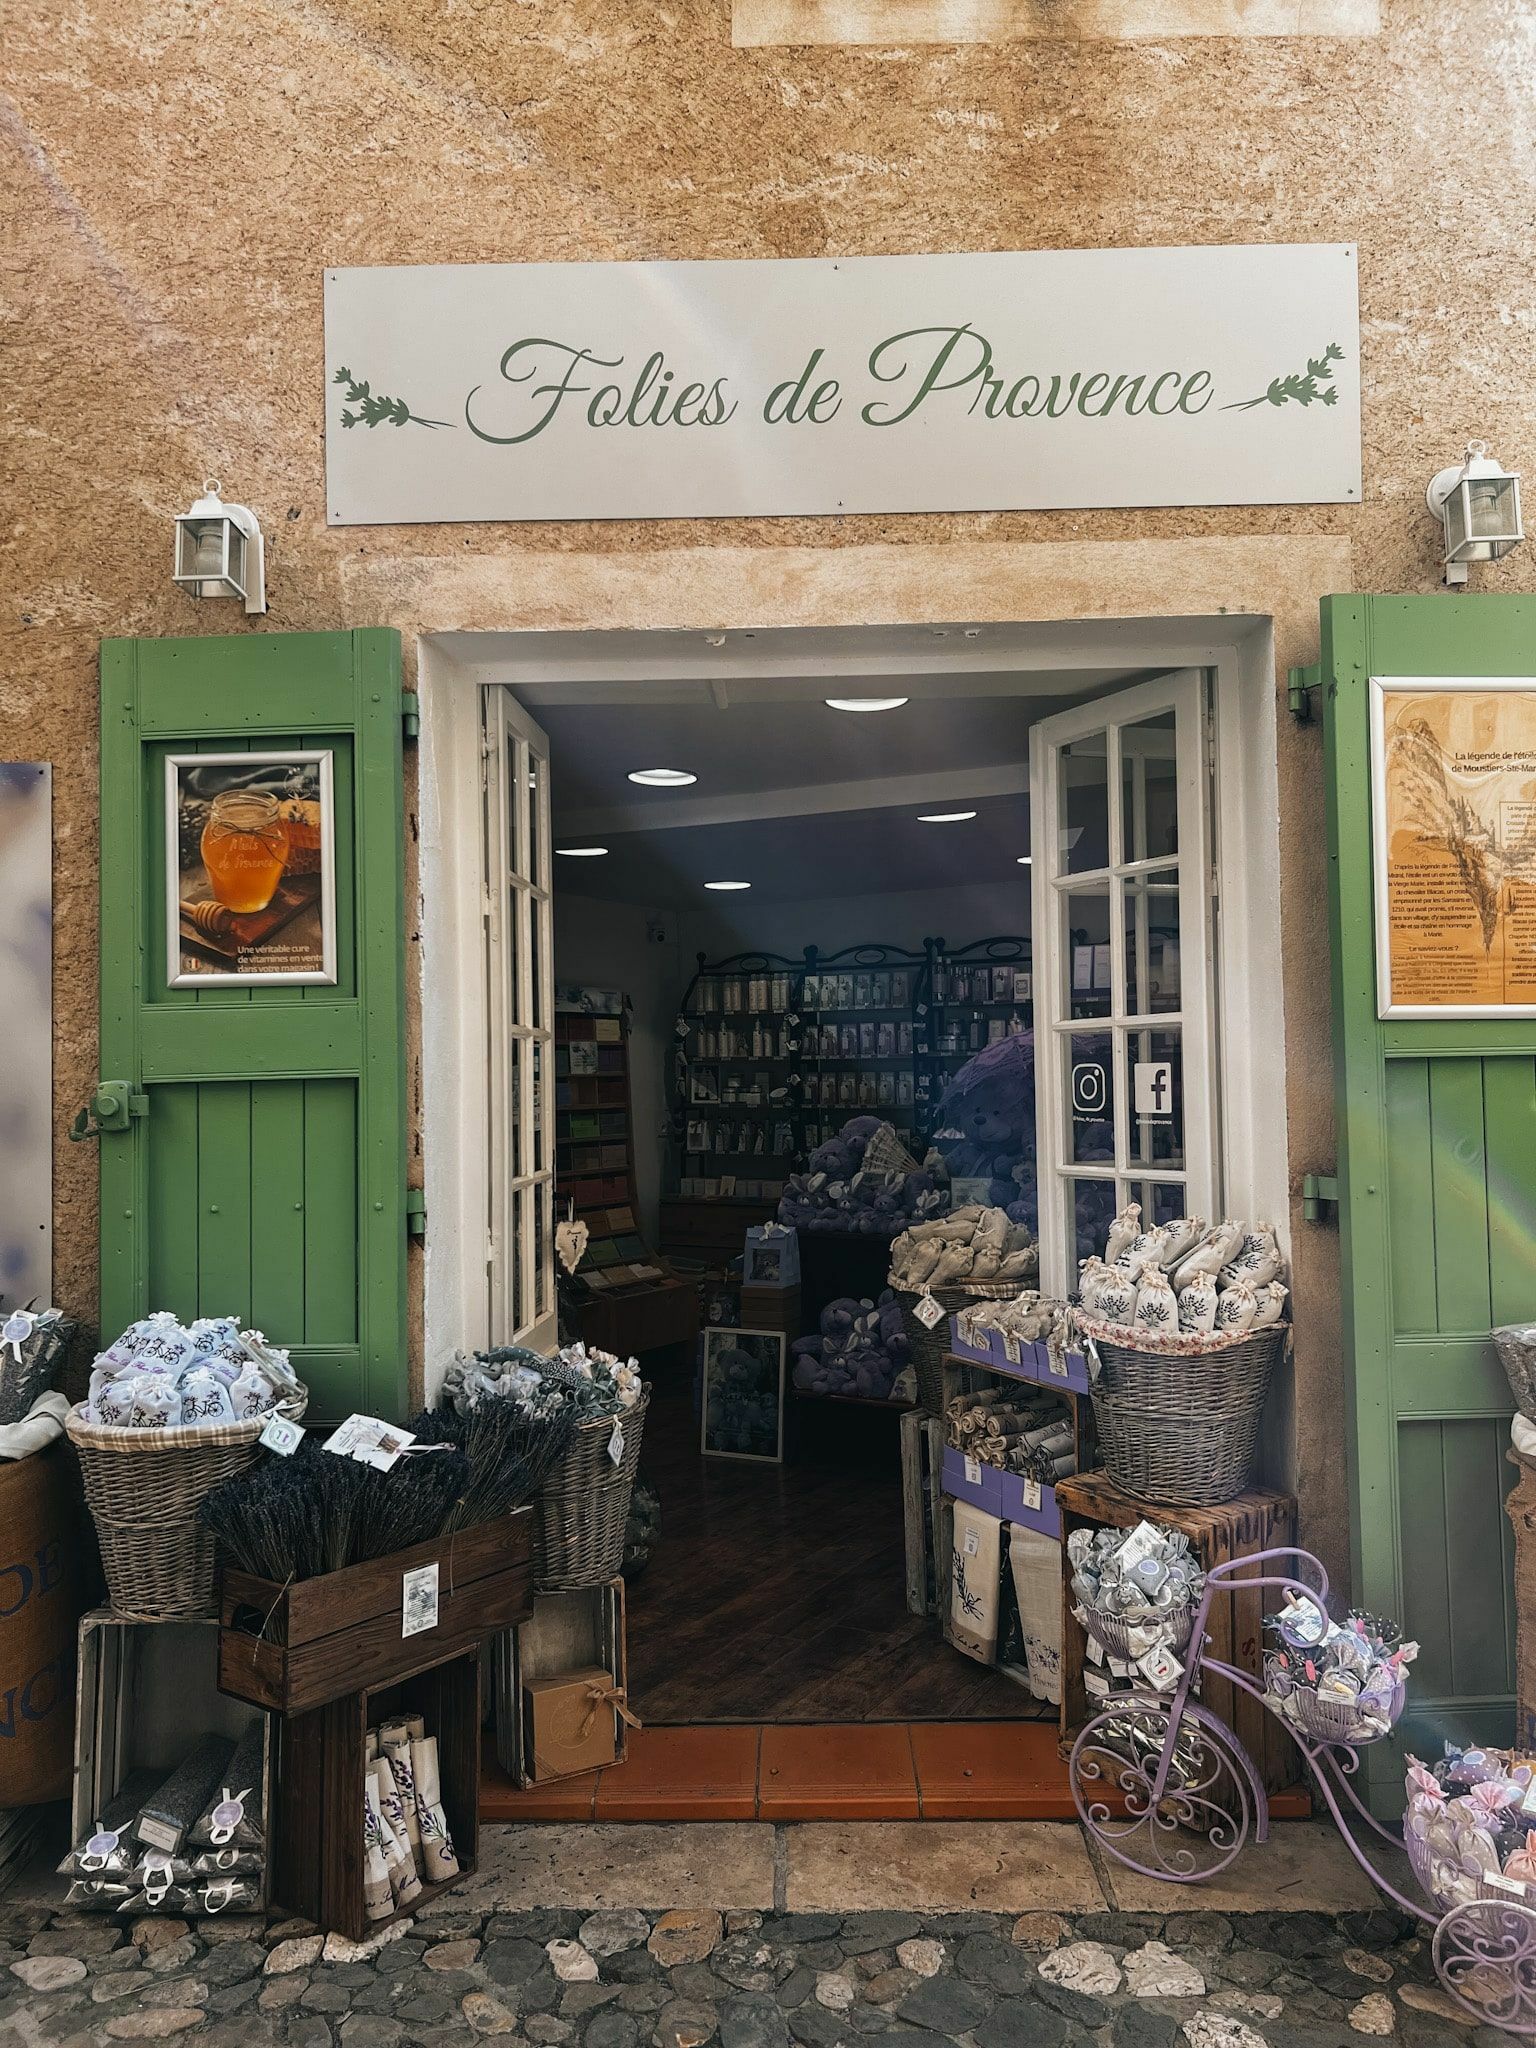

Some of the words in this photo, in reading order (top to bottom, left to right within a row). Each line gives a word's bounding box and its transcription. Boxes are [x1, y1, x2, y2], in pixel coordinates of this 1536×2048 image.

[466, 339, 738, 444] Folies
[764, 349, 842, 424] de
[862, 323, 1214, 426] Provence
[1455, 752, 1466, 760] La
[1467, 751, 1500, 762] légende
[1502, 752, 1512, 760] de
[238, 946, 254, 954] Une
[255, 944, 290, 954] véritable
[238, 956, 248, 964] de
[250, 954, 288, 964] vitamines
[238, 964, 258, 972] dans
[281, 964, 315, 972] magasin
